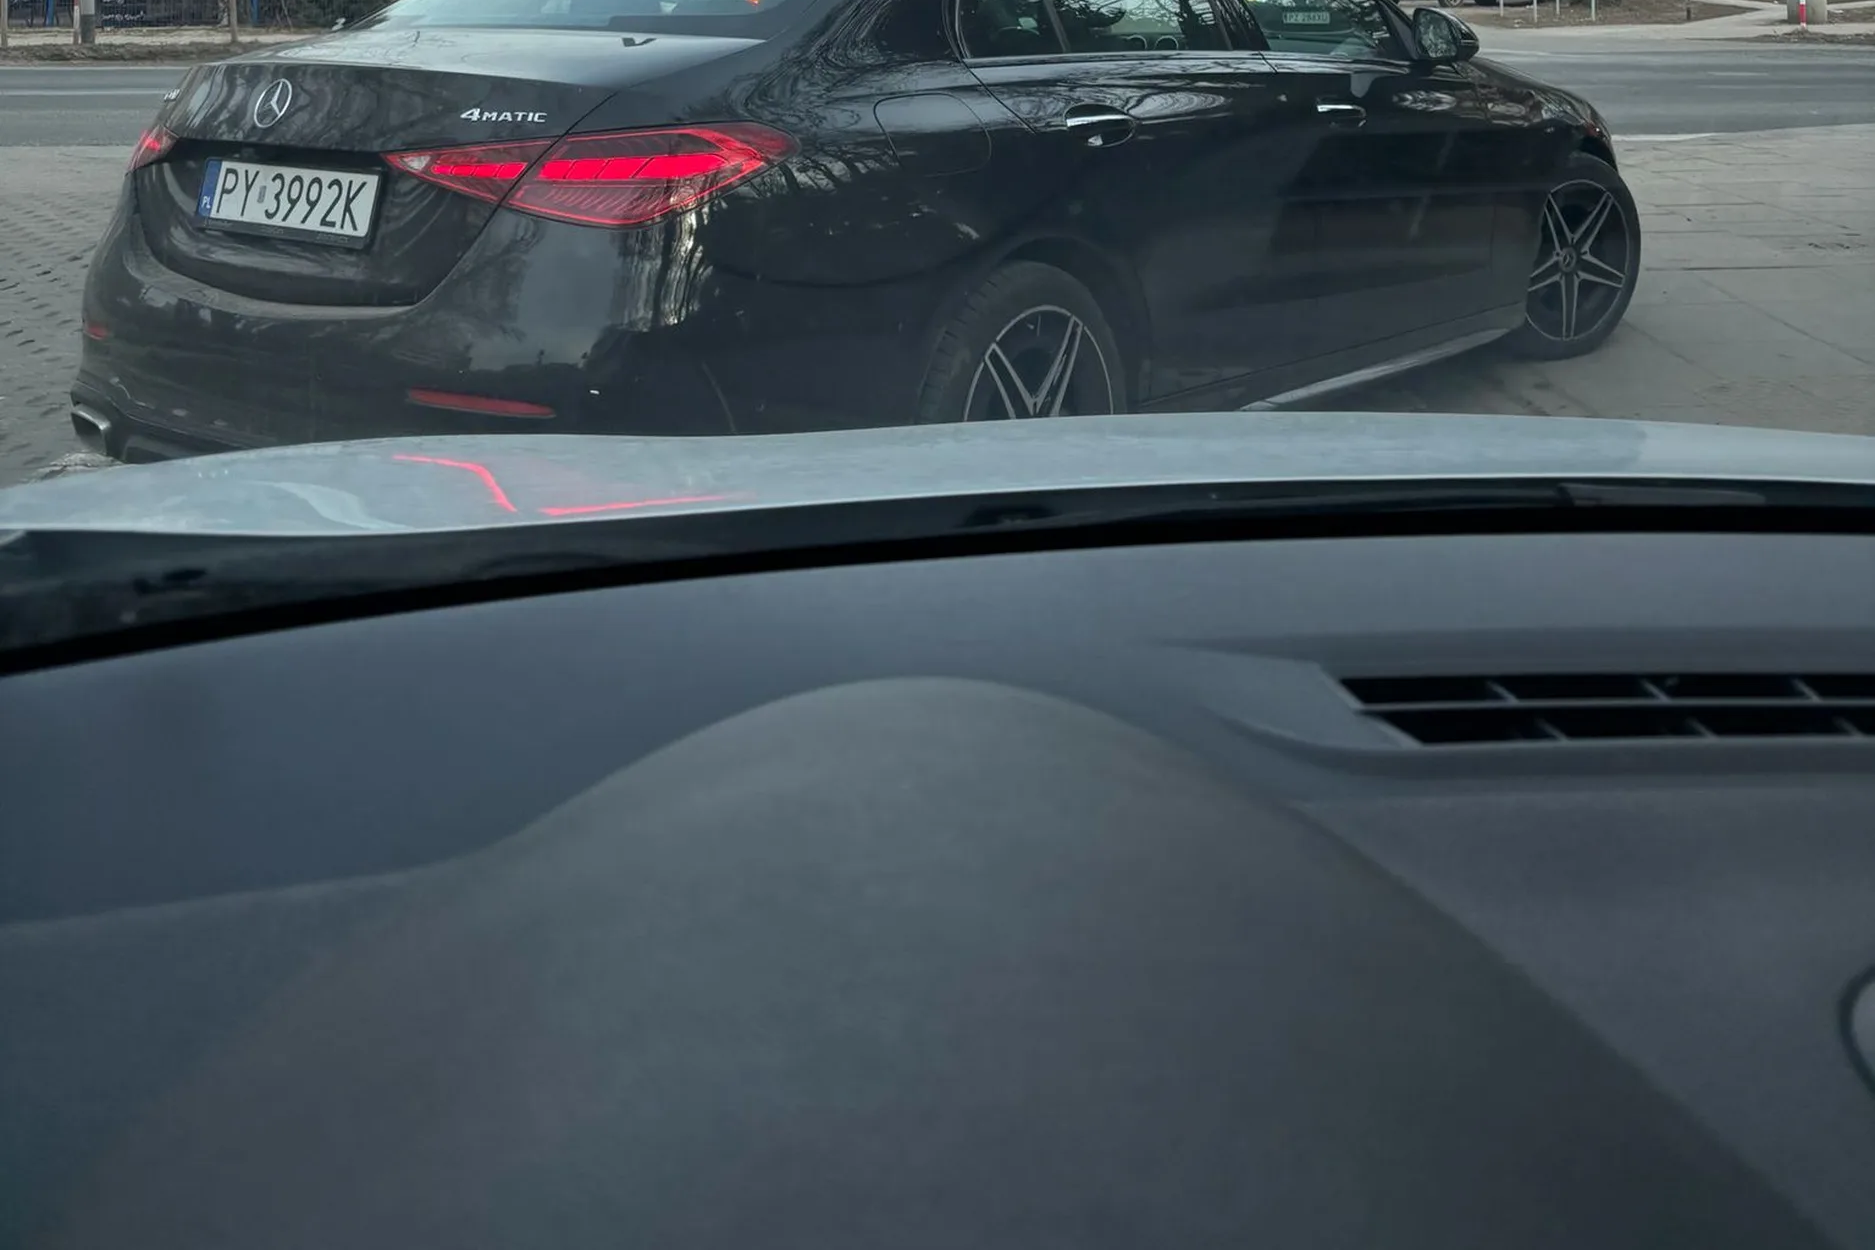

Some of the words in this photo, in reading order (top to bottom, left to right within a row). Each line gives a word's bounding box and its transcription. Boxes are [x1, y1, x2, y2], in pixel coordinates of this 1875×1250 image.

[460, 108, 547, 123] 4MATIC
[201, 195, 211, 209] PL
[215, 167, 260, 217] PY
[264, 172, 368, 232] 3992K
